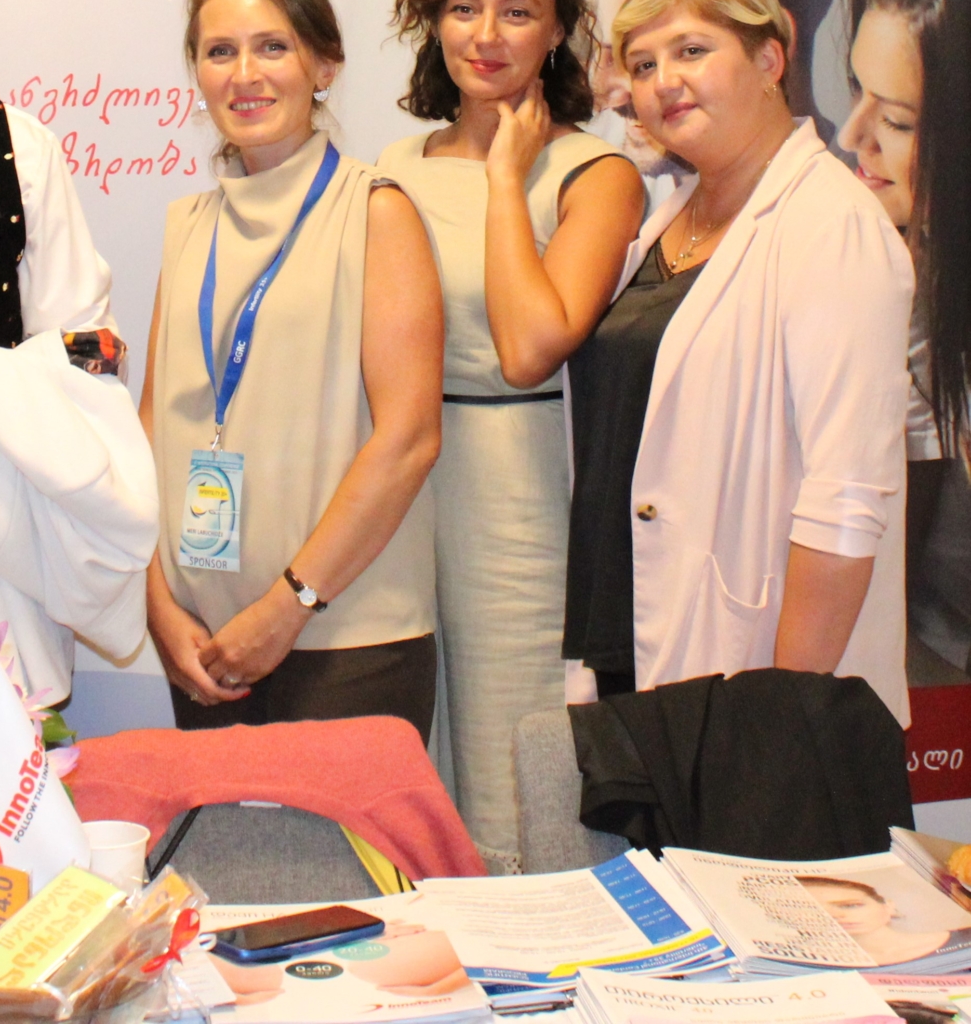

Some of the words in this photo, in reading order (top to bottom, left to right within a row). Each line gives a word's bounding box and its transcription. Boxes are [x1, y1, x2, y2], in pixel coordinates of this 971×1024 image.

[233, 340, 246, 364] GGRC
[189, 556, 228, 569] SPONSOR
[14, 802, 37, 843] FOLLOW
[34, 781, 46, 802] THE
[787, 988, 827, 1002] 4.0
